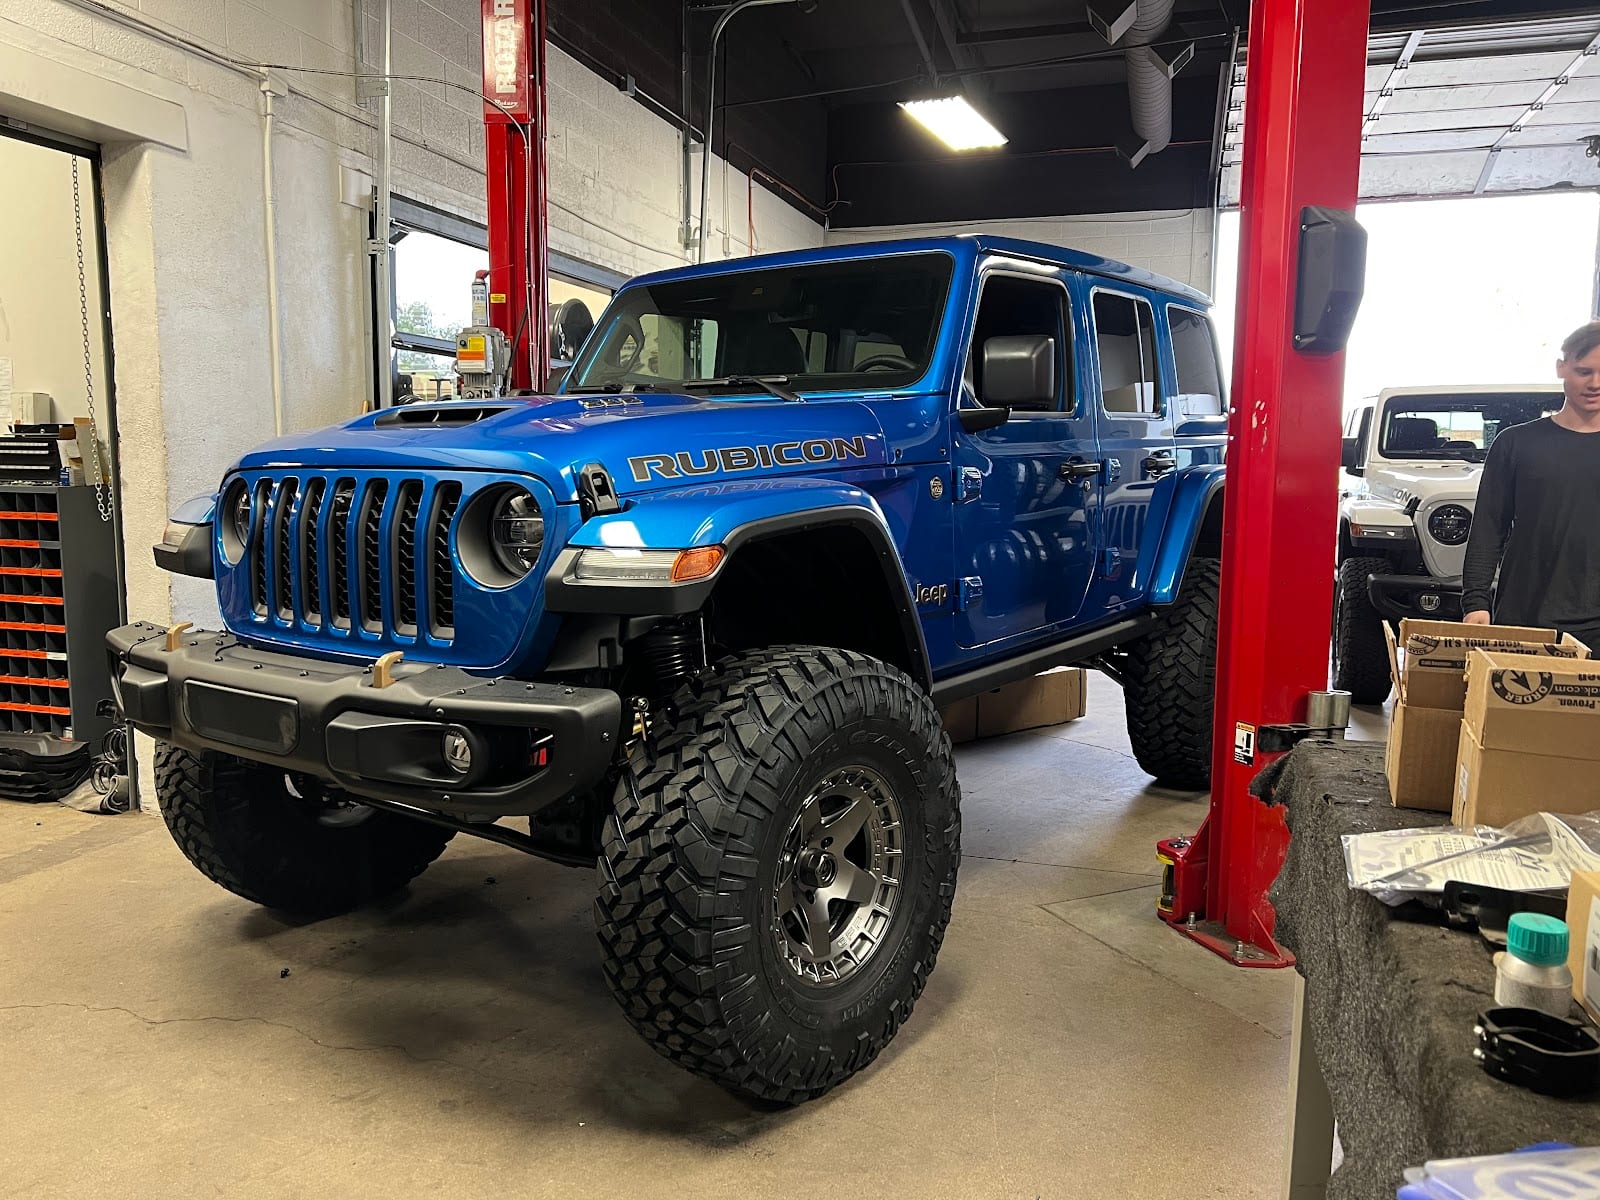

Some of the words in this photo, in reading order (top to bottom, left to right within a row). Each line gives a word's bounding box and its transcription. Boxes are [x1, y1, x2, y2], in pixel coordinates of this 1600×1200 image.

[627, 435, 867, 482] RUBICON
[915, 583, 948, 606] Jeep
[1504, 685, 1548, 703] ORDER
[1558, 698, 1596, 709] Proven.
